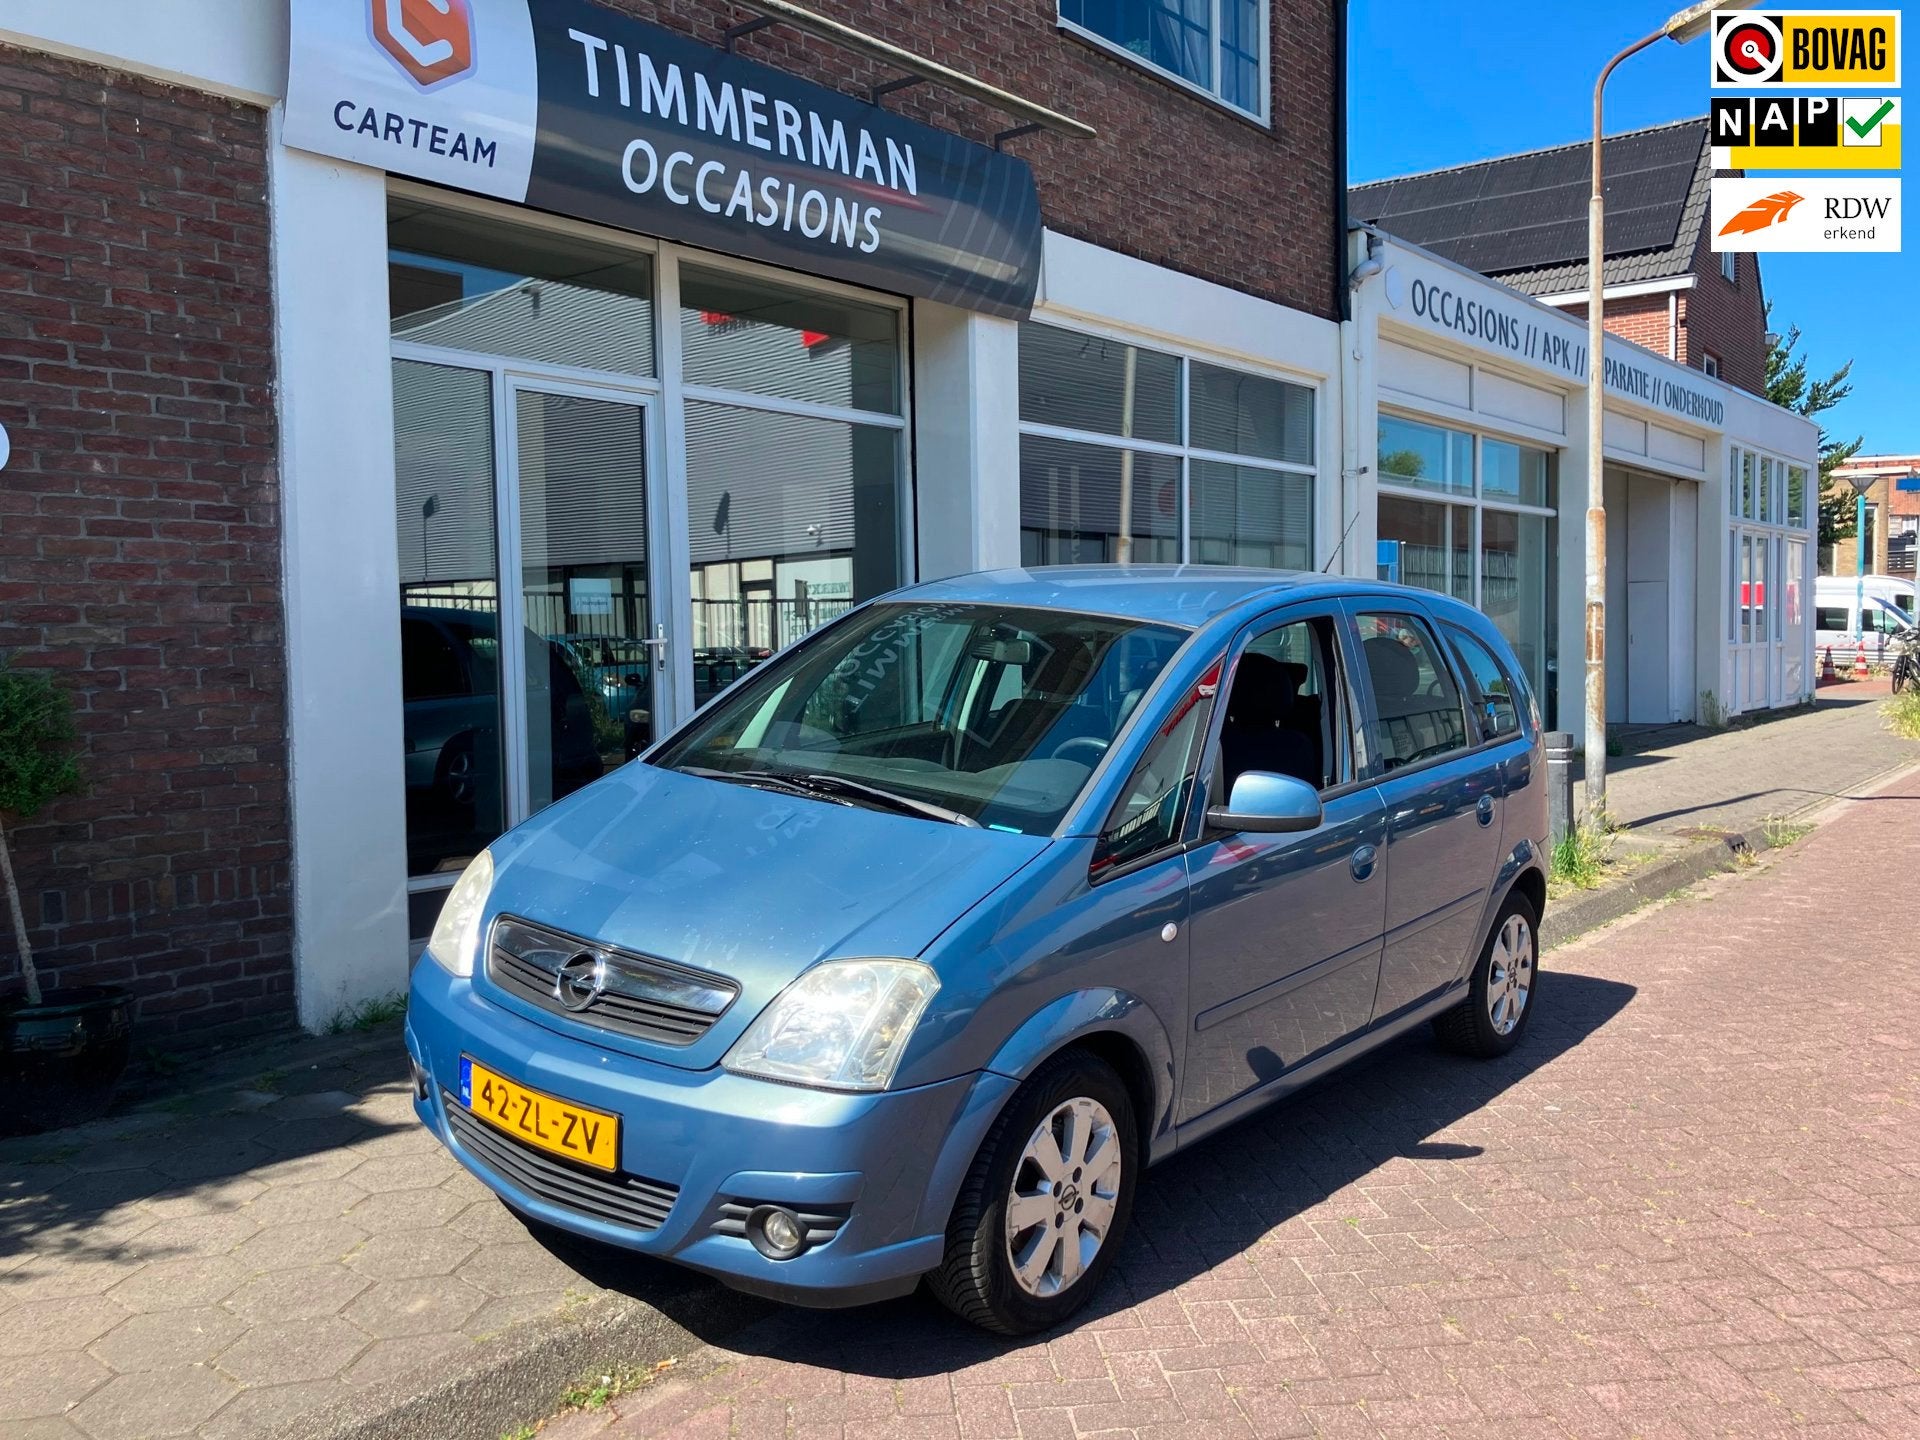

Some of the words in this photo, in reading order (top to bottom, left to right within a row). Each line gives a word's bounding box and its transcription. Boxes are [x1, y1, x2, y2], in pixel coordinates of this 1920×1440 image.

[334, 100, 498, 169] CARTEAM
[568, 27, 918, 196] TIMMERMAN
[622, 139, 882, 254] OCCASIONS
[1411, 278, 1519, 351] OCCASIONS
[1542, 332, 1571, 371] APK
[1604, 356, 1650, 401] PARATIE
[1664, 381, 1724, 425] ONDERHOUD
[481, 1078, 600, 1155] 42-ZL-ZV
